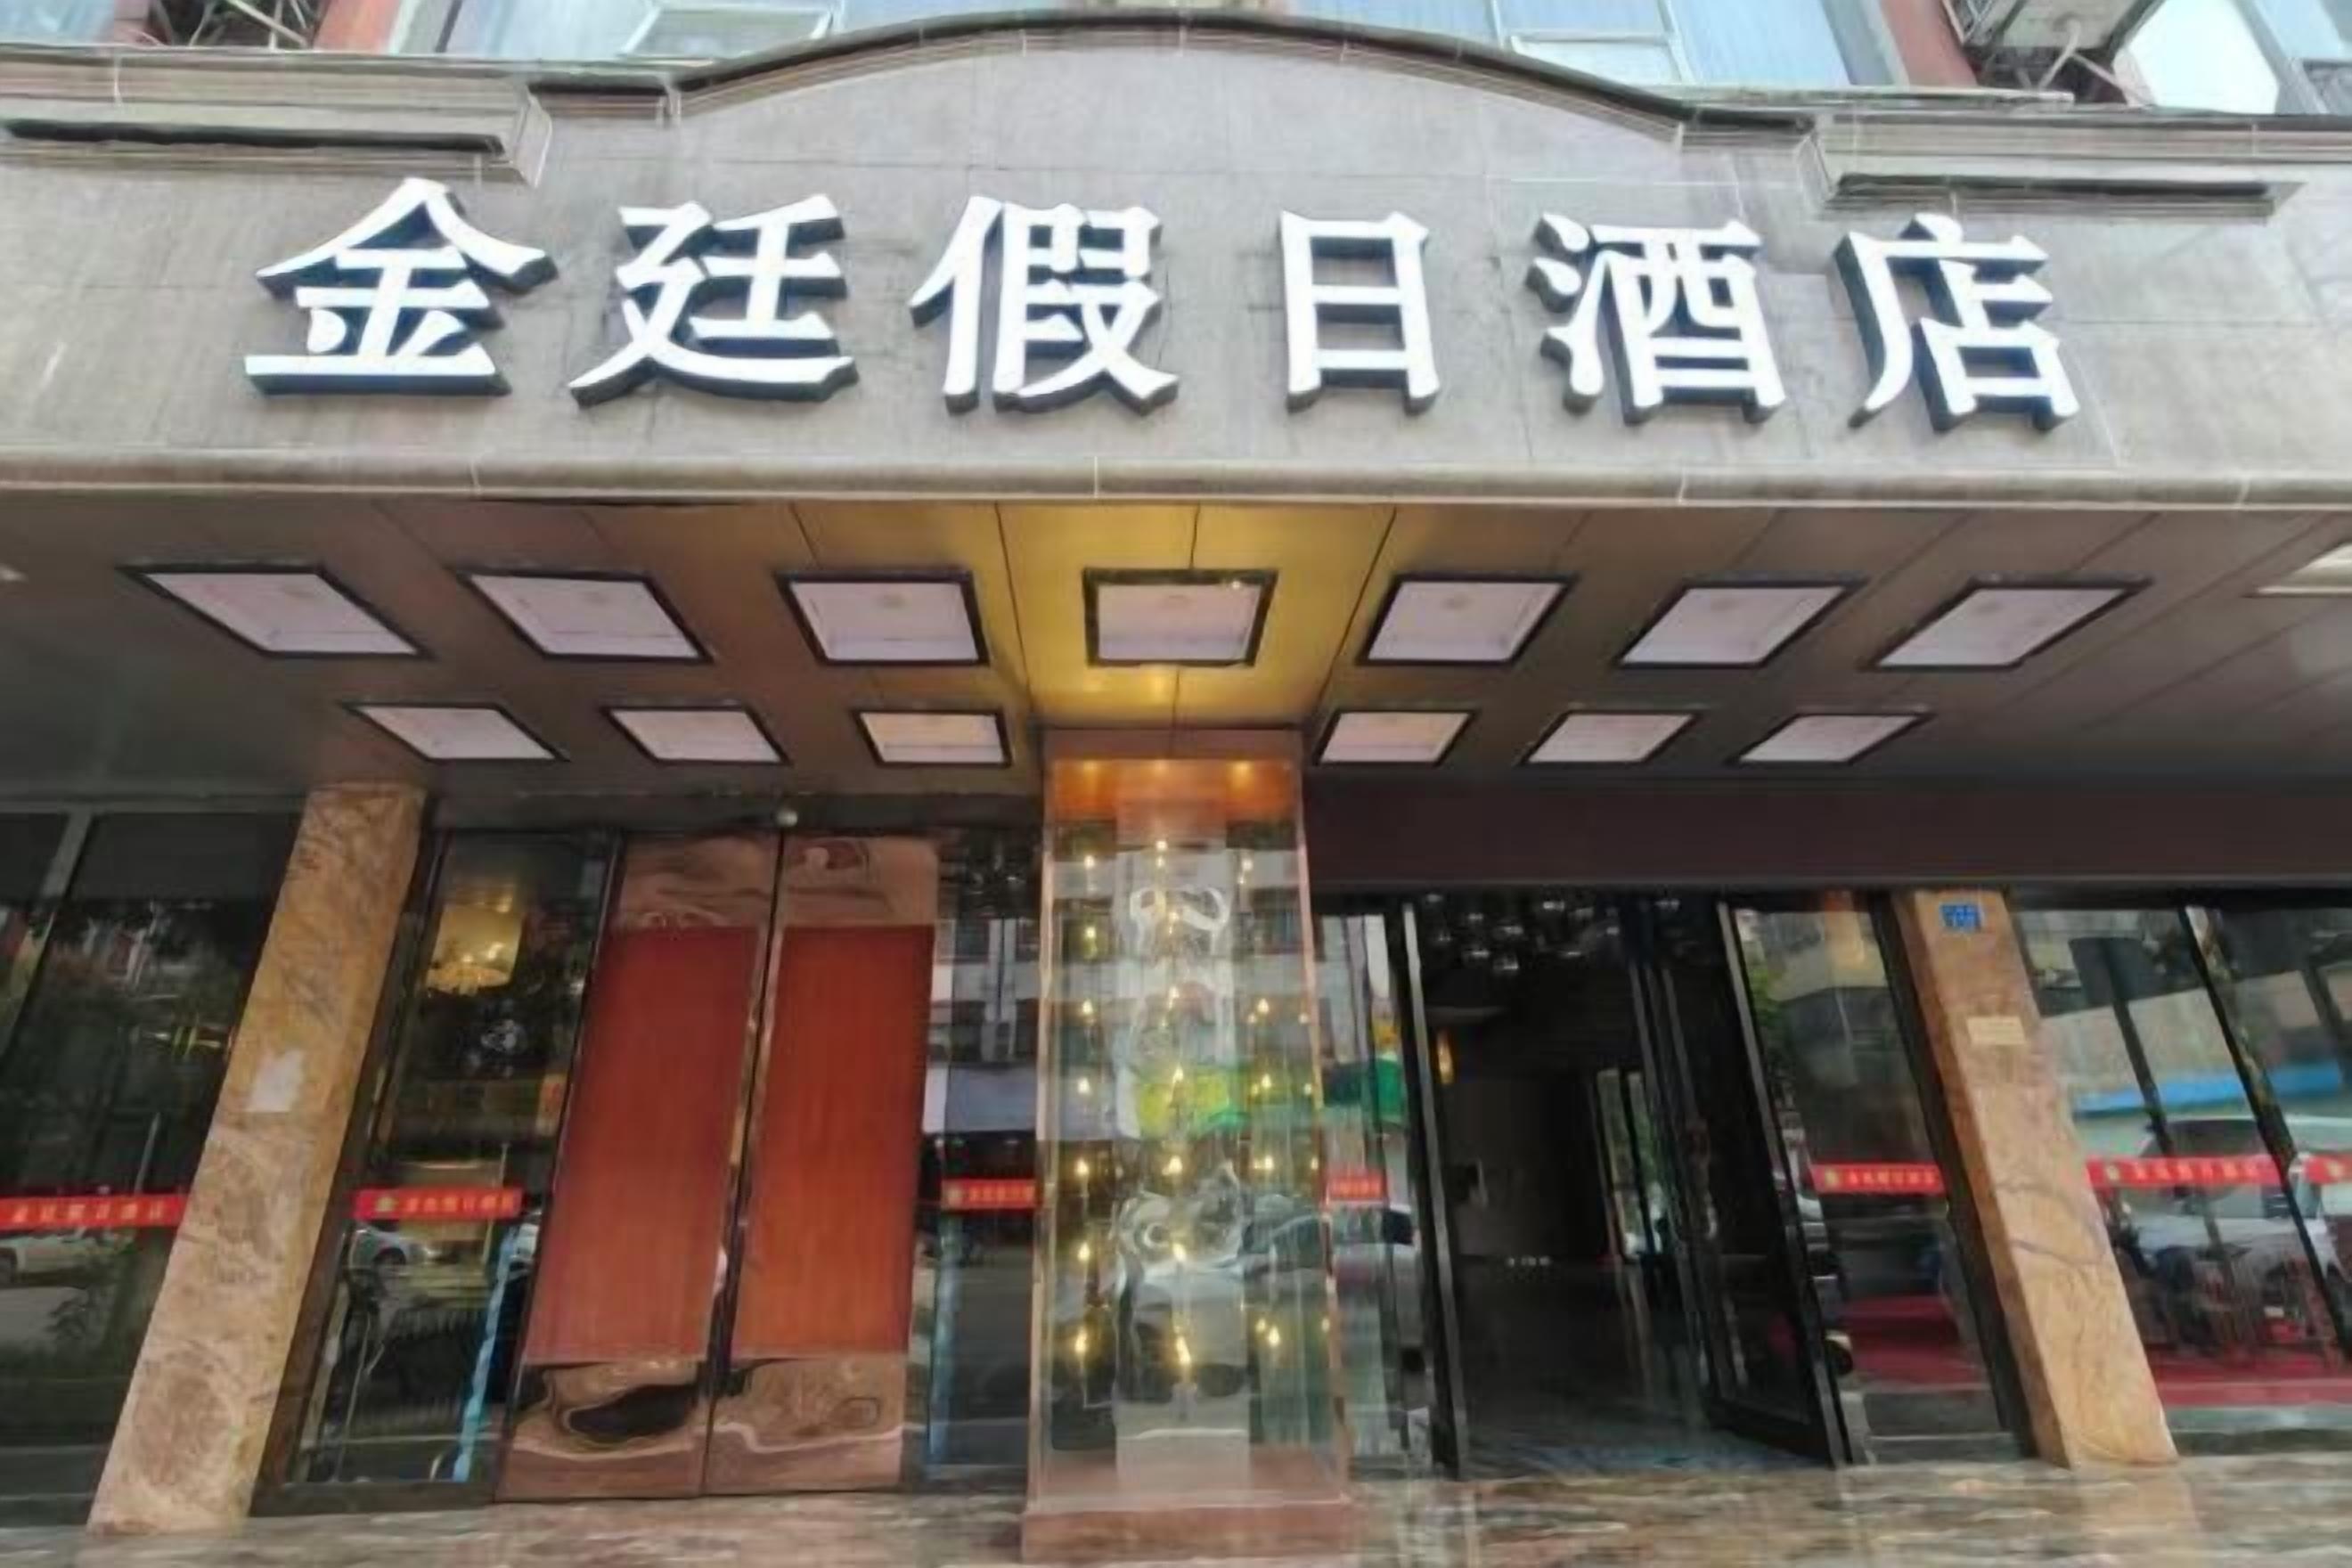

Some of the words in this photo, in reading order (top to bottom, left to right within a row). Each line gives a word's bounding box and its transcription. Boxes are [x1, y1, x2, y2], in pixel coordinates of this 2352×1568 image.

[243, 176, 2079, 429] 金廷假日酒店
